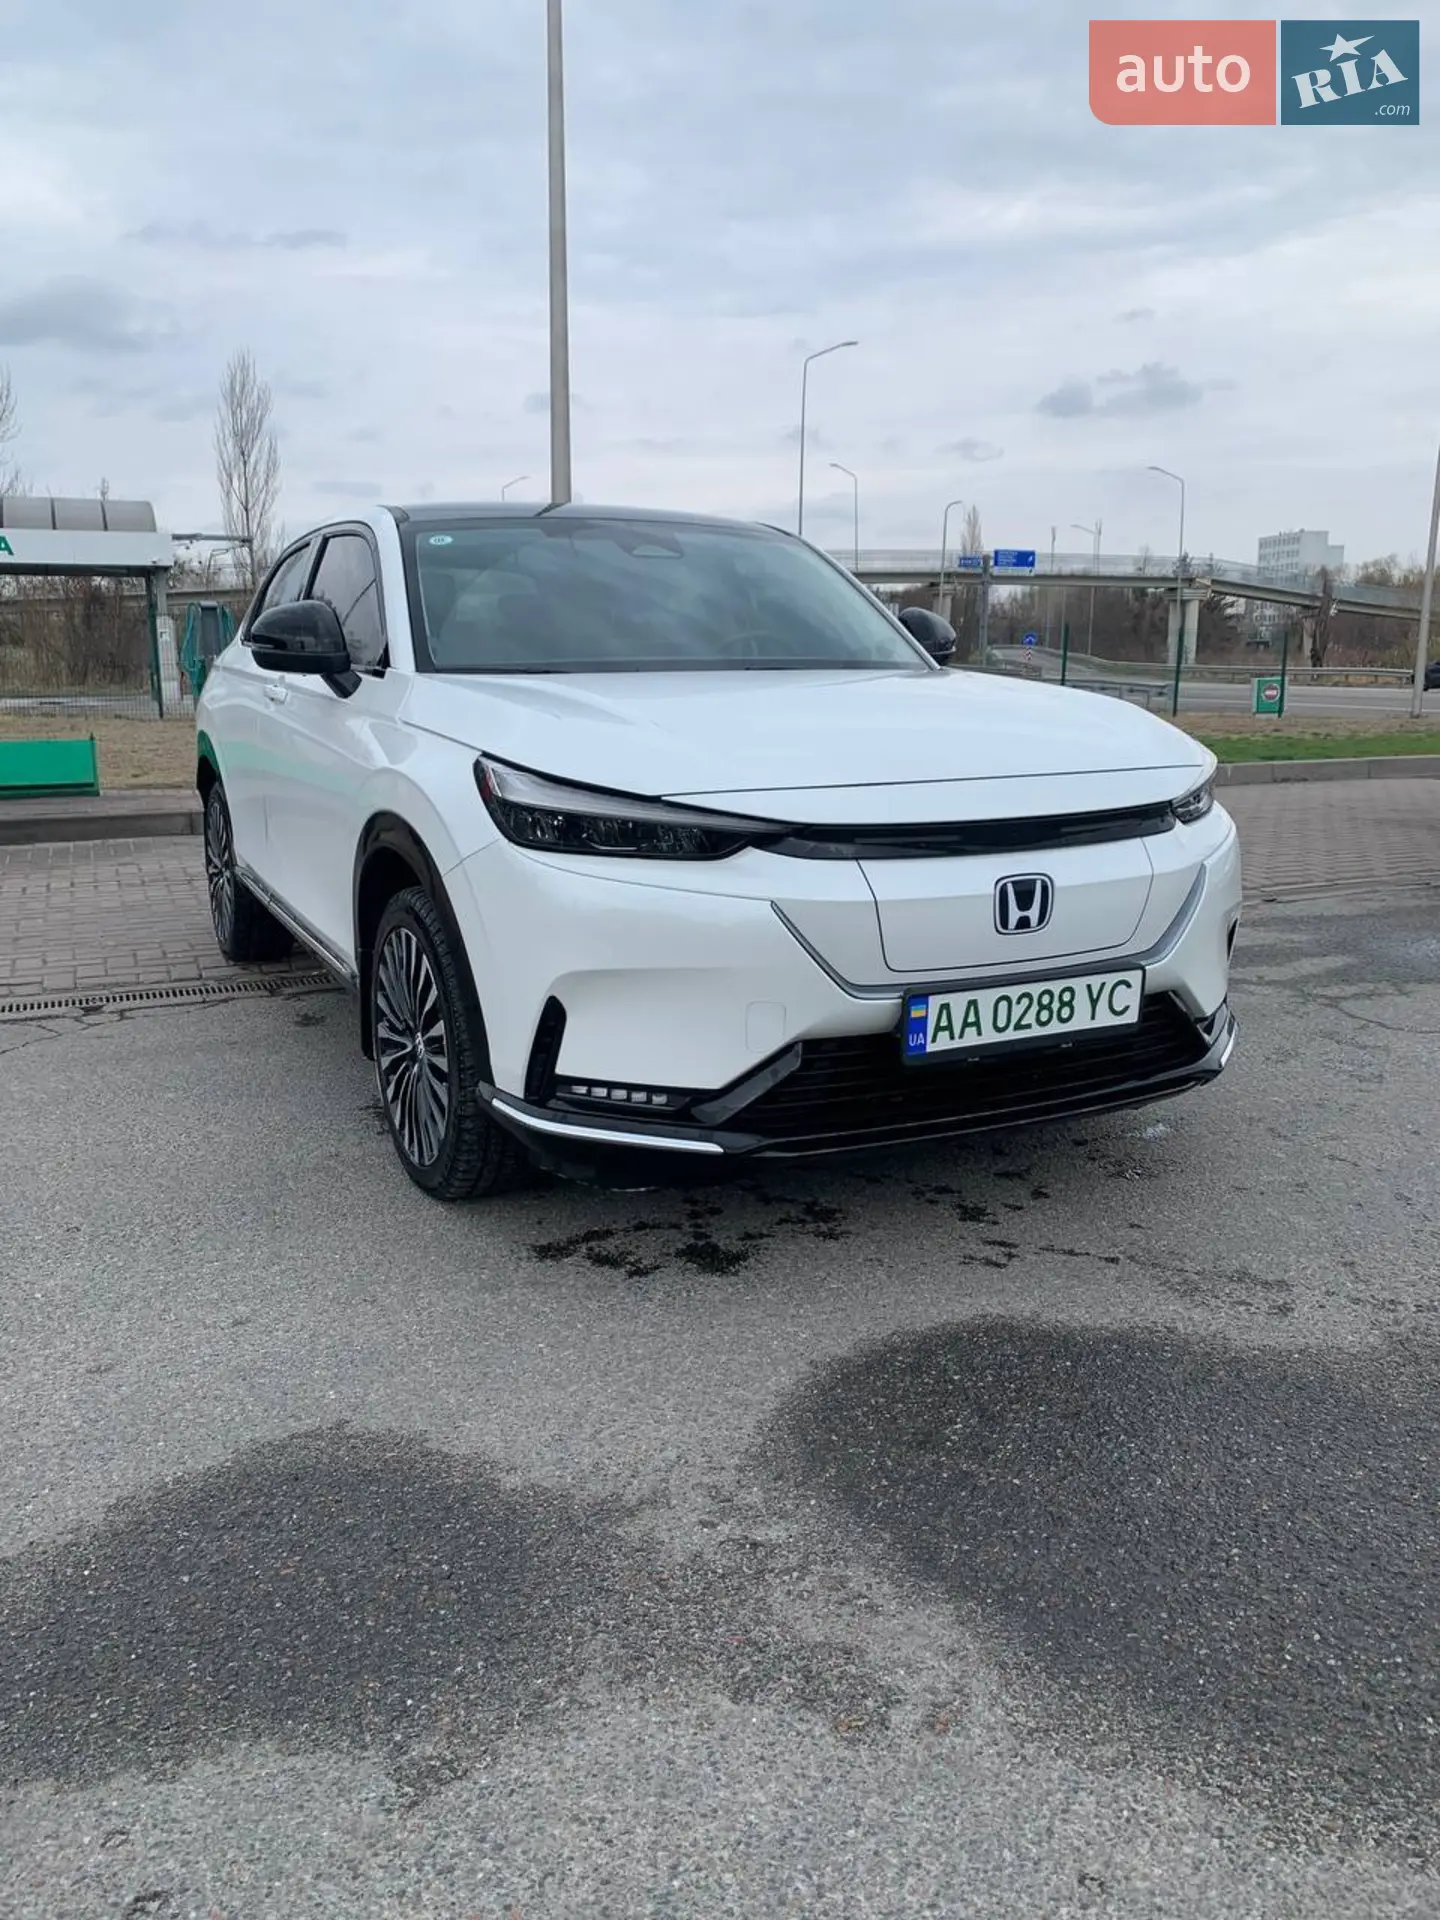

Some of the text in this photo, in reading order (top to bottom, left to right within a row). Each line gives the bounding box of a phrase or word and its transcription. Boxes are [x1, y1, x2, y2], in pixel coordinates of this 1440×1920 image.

[931, 979, 1133, 1044] AA 0288 YC
[909, 1033, 925, 1046] UA
